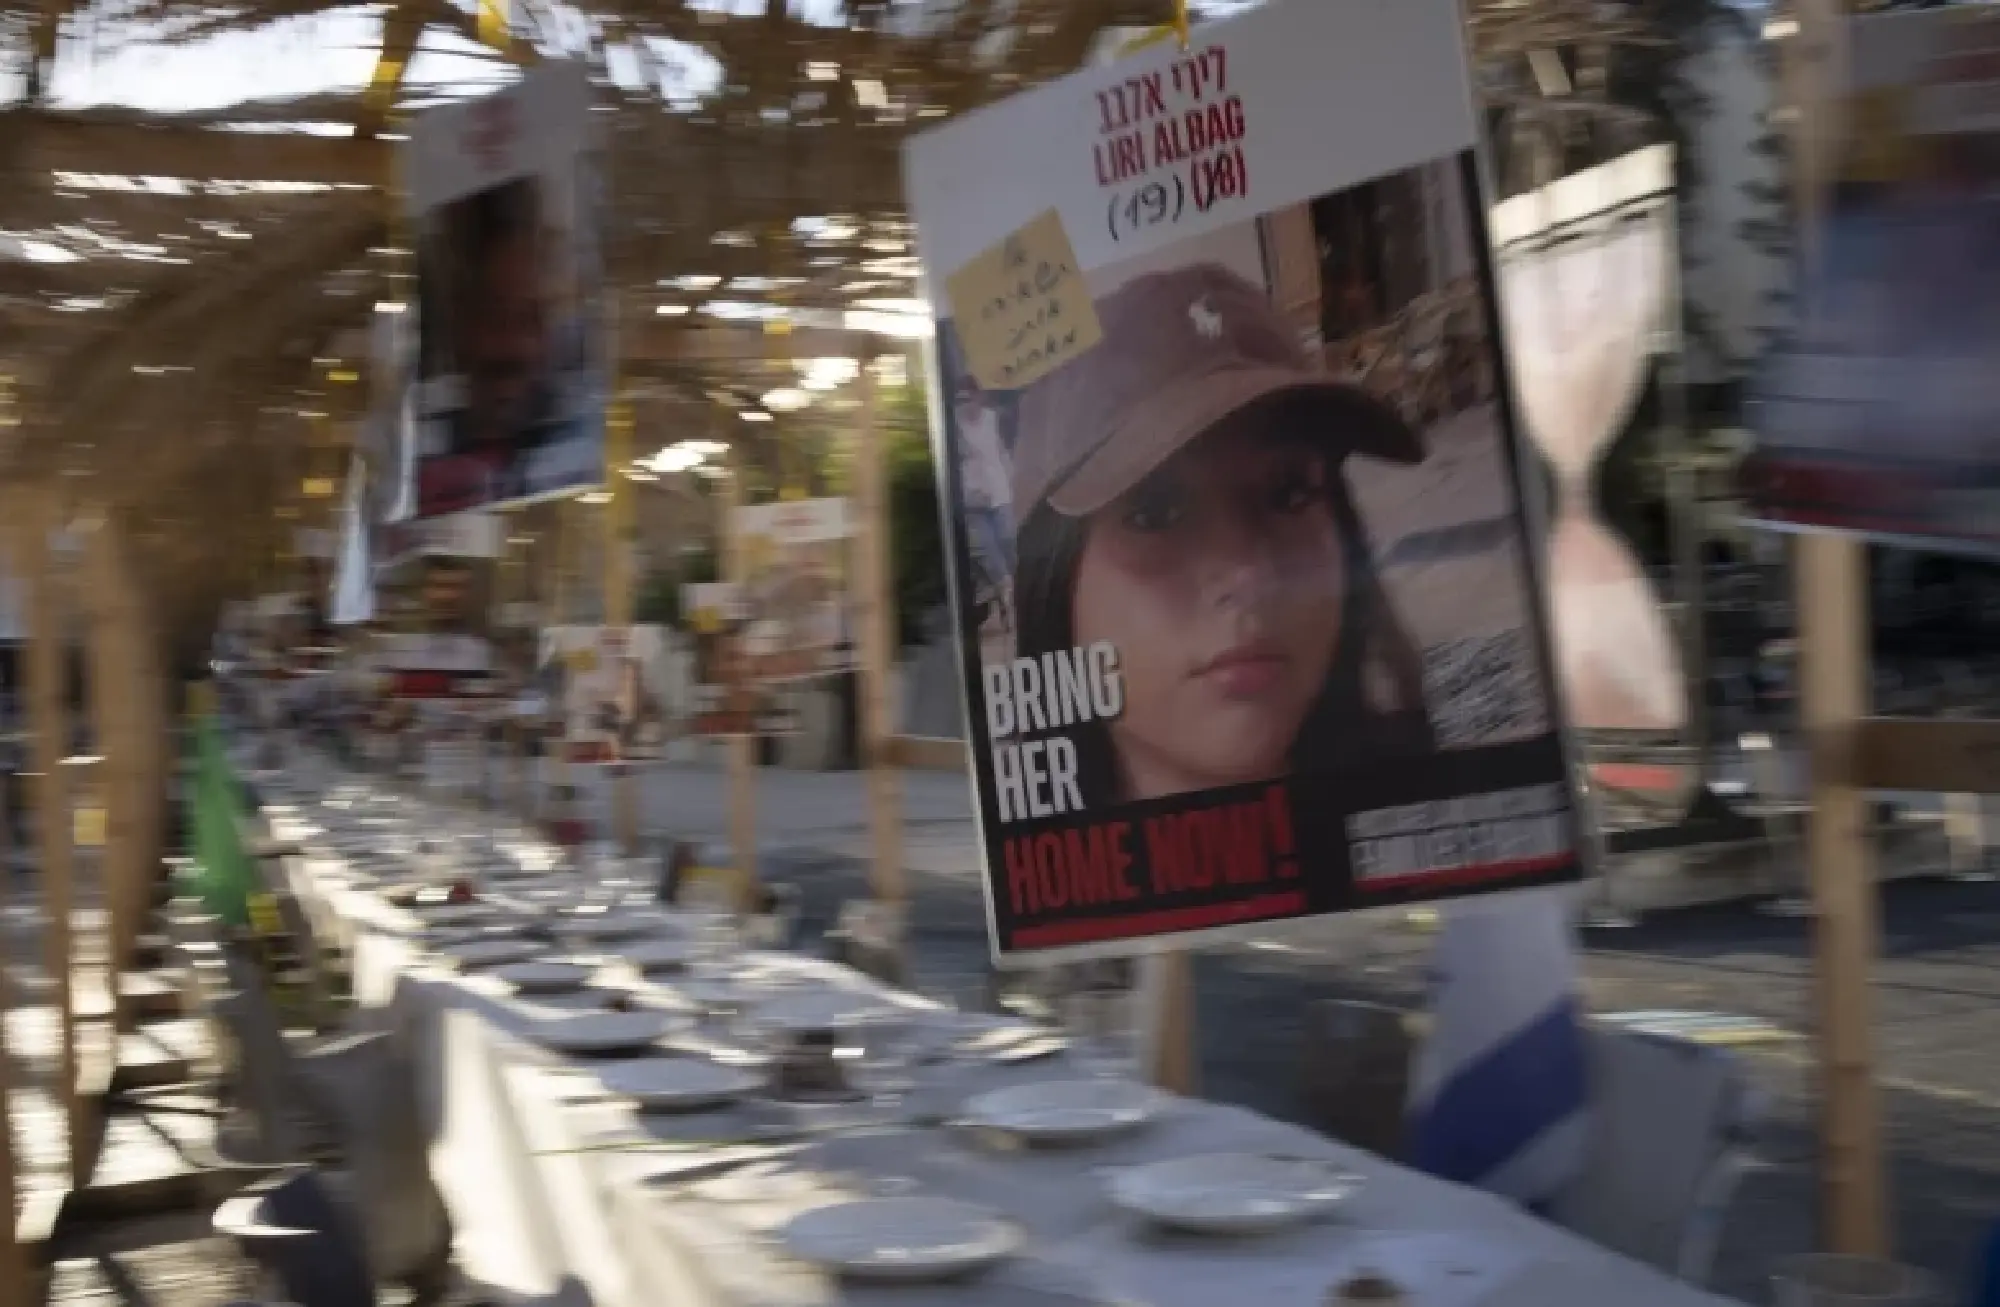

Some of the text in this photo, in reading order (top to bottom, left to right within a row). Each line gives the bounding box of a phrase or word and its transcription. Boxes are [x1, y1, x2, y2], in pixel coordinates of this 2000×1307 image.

[1169, 45, 1226, 101] לירי
[1092, 95, 1246, 186] LIRI ALBAG
[1108, 173, 1185, 242] (19)
[984, 641, 1122, 737] BRING
[993, 737, 1085, 823] HER
[1004, 821, 1139, 915] HOME
[1144, 785, 1299, 895] NOW!
